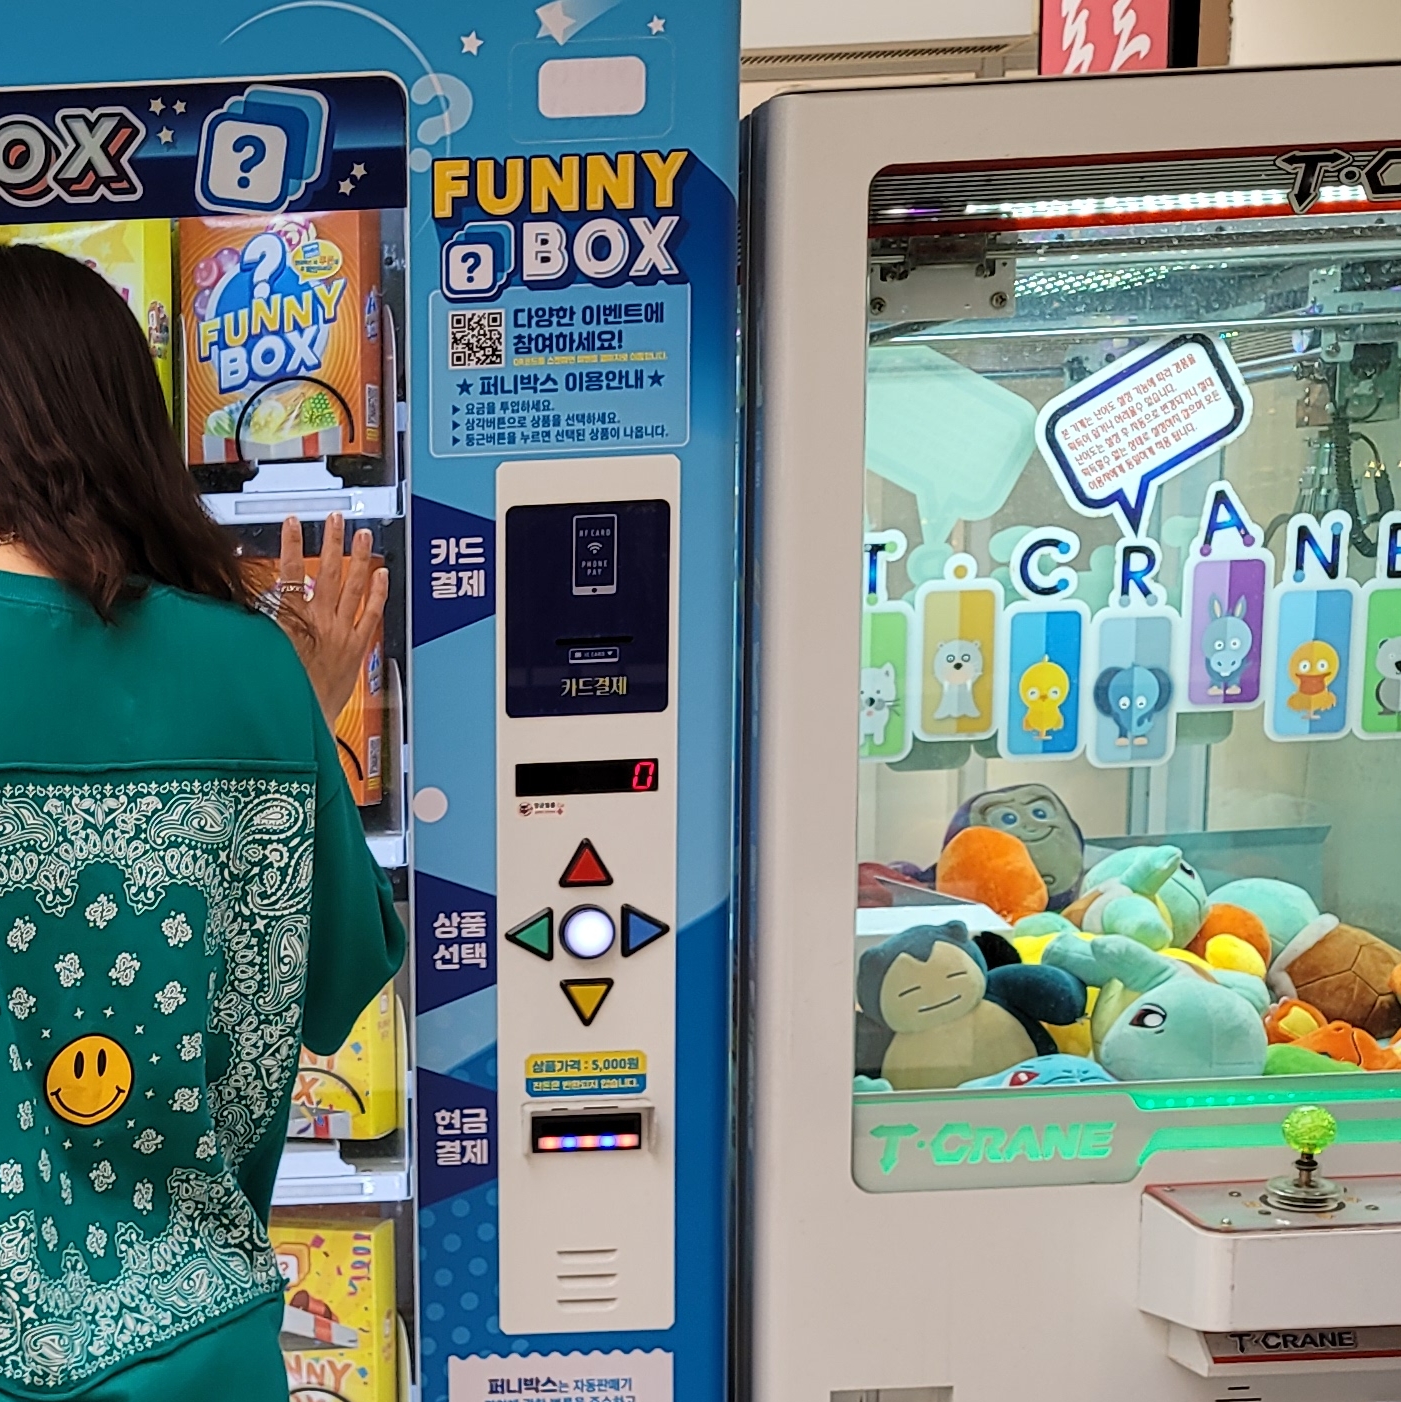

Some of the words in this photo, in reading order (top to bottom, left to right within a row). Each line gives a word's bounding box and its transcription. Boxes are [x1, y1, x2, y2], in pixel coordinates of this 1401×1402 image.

[433, 151, 689, 219] FUNNY
[523, 216, 680, 281] BOX
[200, 279, 348, 361] FUNNY
[513, 306, 576, 329] 다양한
[581, 302, 665, 326] 이벤트에
[512, 330, 624, 355] 참여하세요!
[216, 331, 321, 393] BOX
[478, 372, 559, 396] 퍼니박스
[564, 369, 644, 393] 이용안내
[465, 402, 496, 415] 요금을
[465, 416, 527, 431] 삼각버튼으로
[530, 414, 561, 428] 상품을
[565, 412, 621, 426] 선택하세요.
[1093, 401, 1117, 421] 난이도
[465, 431, 516, 446] 둥근버튼을
[520, 430, 551, 444] 누르면
[555, 428, 586, 443] 선택된
[589, 427, 620, 441] 상품이
[623, 424, 669, 440] 나옵니다.
[1075, 442, 1105, 465] 난이도는
[431, 536, 485, 565] 카드
[431, 569, 486, 599] 결제
[560, 675, 627, 697] 카드결제
[632, 761, 655, 790] 0
[432, 911, 487, 939] 상품
[433, 942, 487, 970] 선택
[591, 1057, 639, 1072] 5,000원
[434, 1108, 488, 1135] 현금
[435, 1138, 489, 1166] 결제
[286, 1354, 353, 1394] NNY
[488, 1377, 569, 1395] 퍼니박스는
[573, 1378, 633, 1392] 자동판매기
